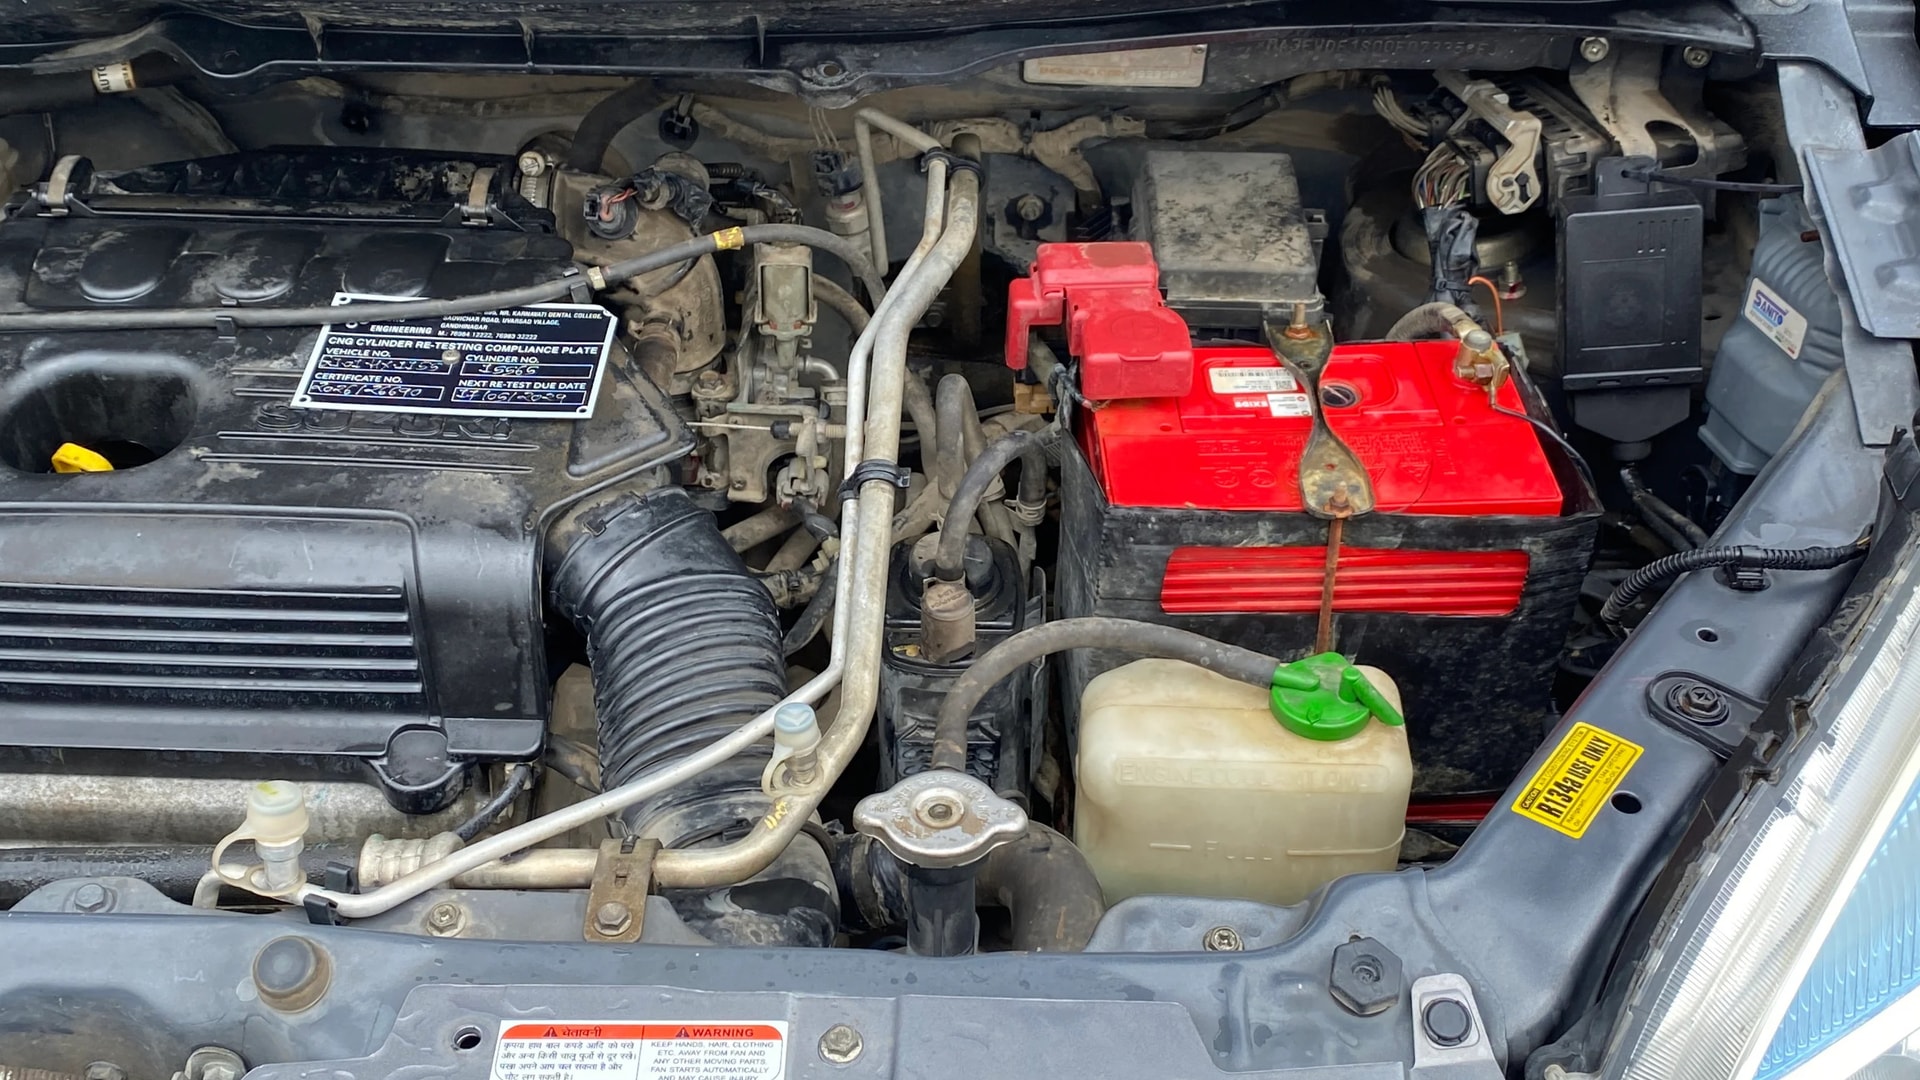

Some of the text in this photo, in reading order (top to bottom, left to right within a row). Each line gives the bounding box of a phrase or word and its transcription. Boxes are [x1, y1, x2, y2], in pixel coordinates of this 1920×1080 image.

[369, 325, 433, 335] ENGINEERING
[328, 336, 598, 355] CNG CYLINDER RE-TESTING COMPLIANCE PLATE
[325, 348, 391, 358] VEHICLE NO.
[465, 354, 540, 364] CYLINDER NO.
[314, 372, 403, 384] CERTIFICATE NO.
[458, 380, 587, 390] NEXT RE-TEST DUE DATE
[1119, 762, 1203, 785] ENGINE
[1536, 736, 1612, 819] R134a USE ONLY
[1521, 789, 1540, 808] CAUTION
[562, 1026, 602, 1037] चेतावनी
[692, 1028, 754, 1038] WARNING
